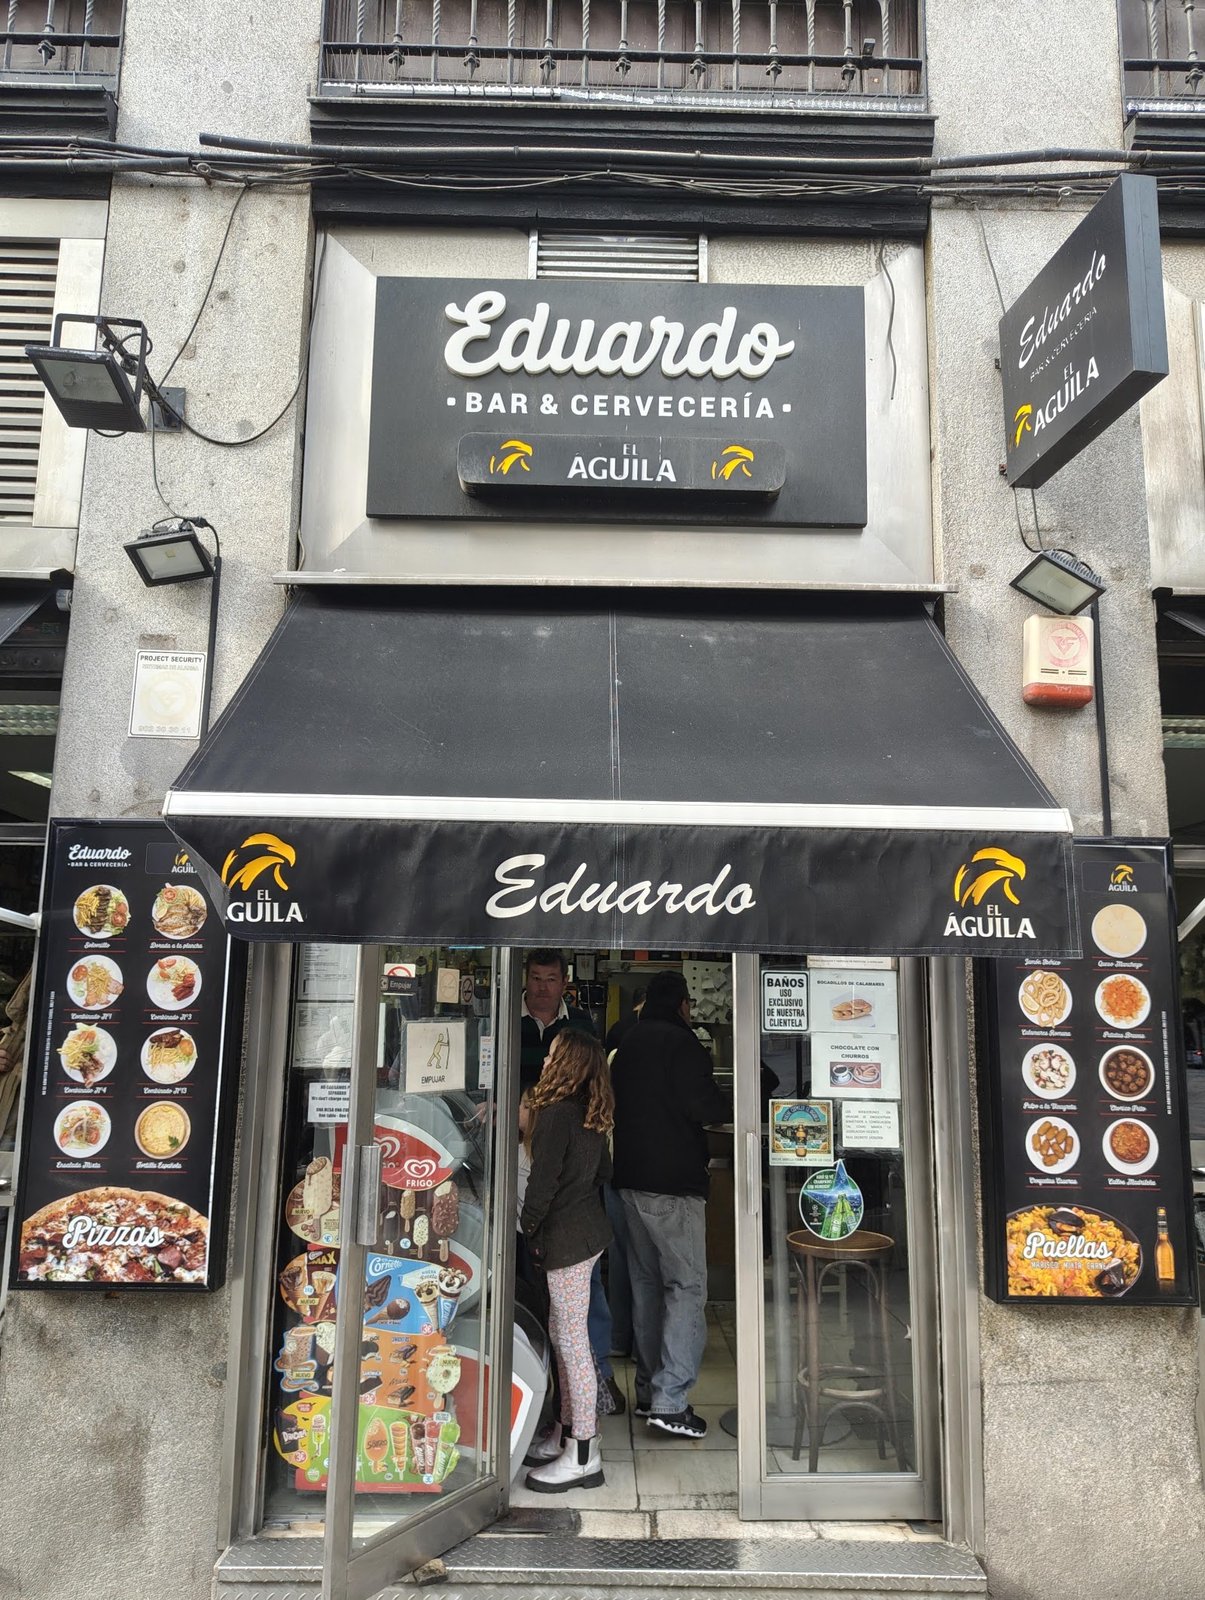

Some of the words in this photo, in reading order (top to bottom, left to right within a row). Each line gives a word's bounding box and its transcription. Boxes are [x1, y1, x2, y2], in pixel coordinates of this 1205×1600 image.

[1018, 250, 1107, 370] Eduardo
[444, 290, 796, 379] Eduardo
[1064, 362, 1074, 381] EL
[466, 391, 528, 415] BAR
[540, 393, 559, 415] &
[570, 391, 775, 419] CERVECERÍA
[623, 443, 638, 456] EL
[68, 844, 132, 861] Eduardo
[484, 852, 757, 920] Eduardo
[257, 889, 272, 901] EL
[225, 901, 305, 923] GUILA
[986, 903, 1002, 916] EL
[943, 912, 1038, 940] ÁGUILA
[389, 980, 412, 990] Empujar
[766, 976, 804, 988] BAÑOS
[780, 988, 792, 997] USO
[768, 998, 803, 1007] EXCLUSIVO
[766, 1008, 776, 1017] DE
[776, 1009, 806, 1017] NUESTRA
[770, 1018, 802, 1027] CLIENTELA
[420, 1075, 446, 1084] EMPUJAR
[62, 1215, 165, 1249] Pizzas
[1023, 1231, 1113, 1259] Paellas
[369, 1257, 402, 1276] Cornetto
